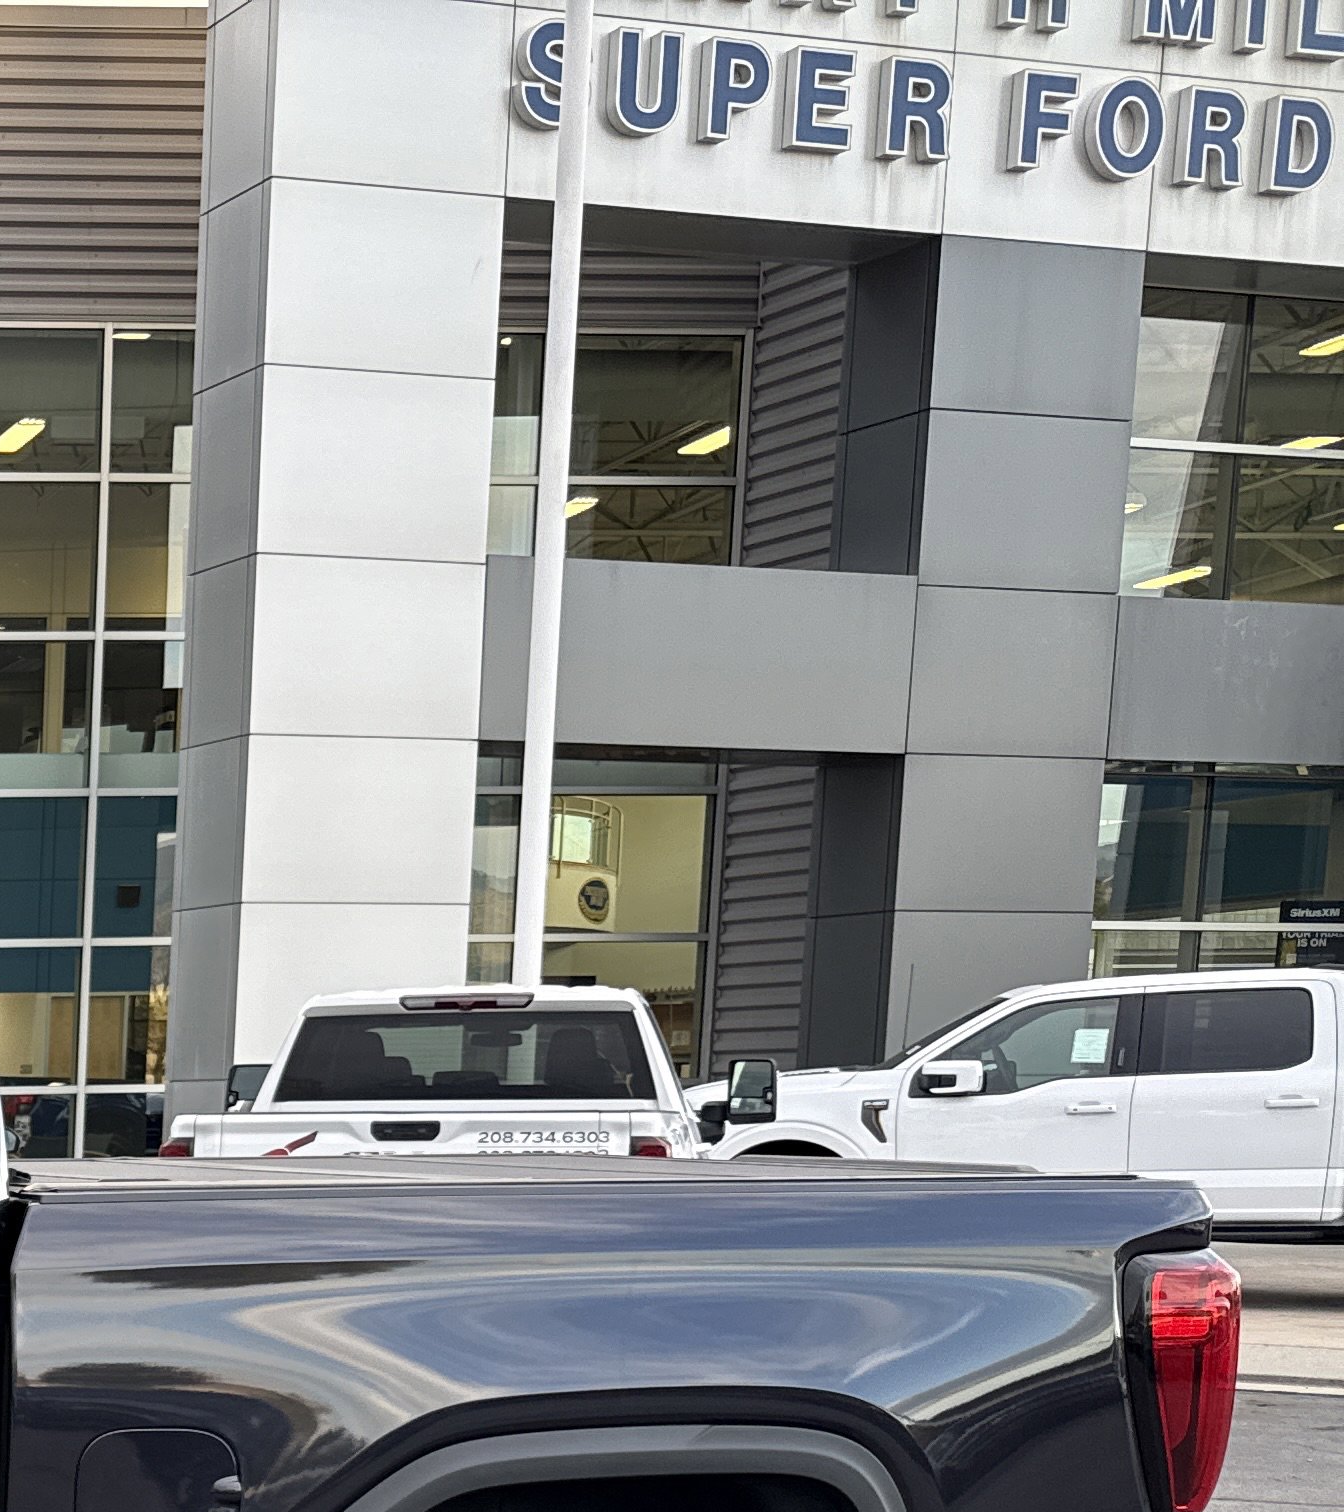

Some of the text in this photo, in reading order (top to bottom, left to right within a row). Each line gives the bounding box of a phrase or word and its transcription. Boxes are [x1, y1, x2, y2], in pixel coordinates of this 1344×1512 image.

[512, 18, 1334, 197] SUPER FORD
[1289, 907, 1341, 918] SiriusXM
[1297, 938, 1327, 948] IS ON
[477, 1131, 611, 1144] 208.734.6303
